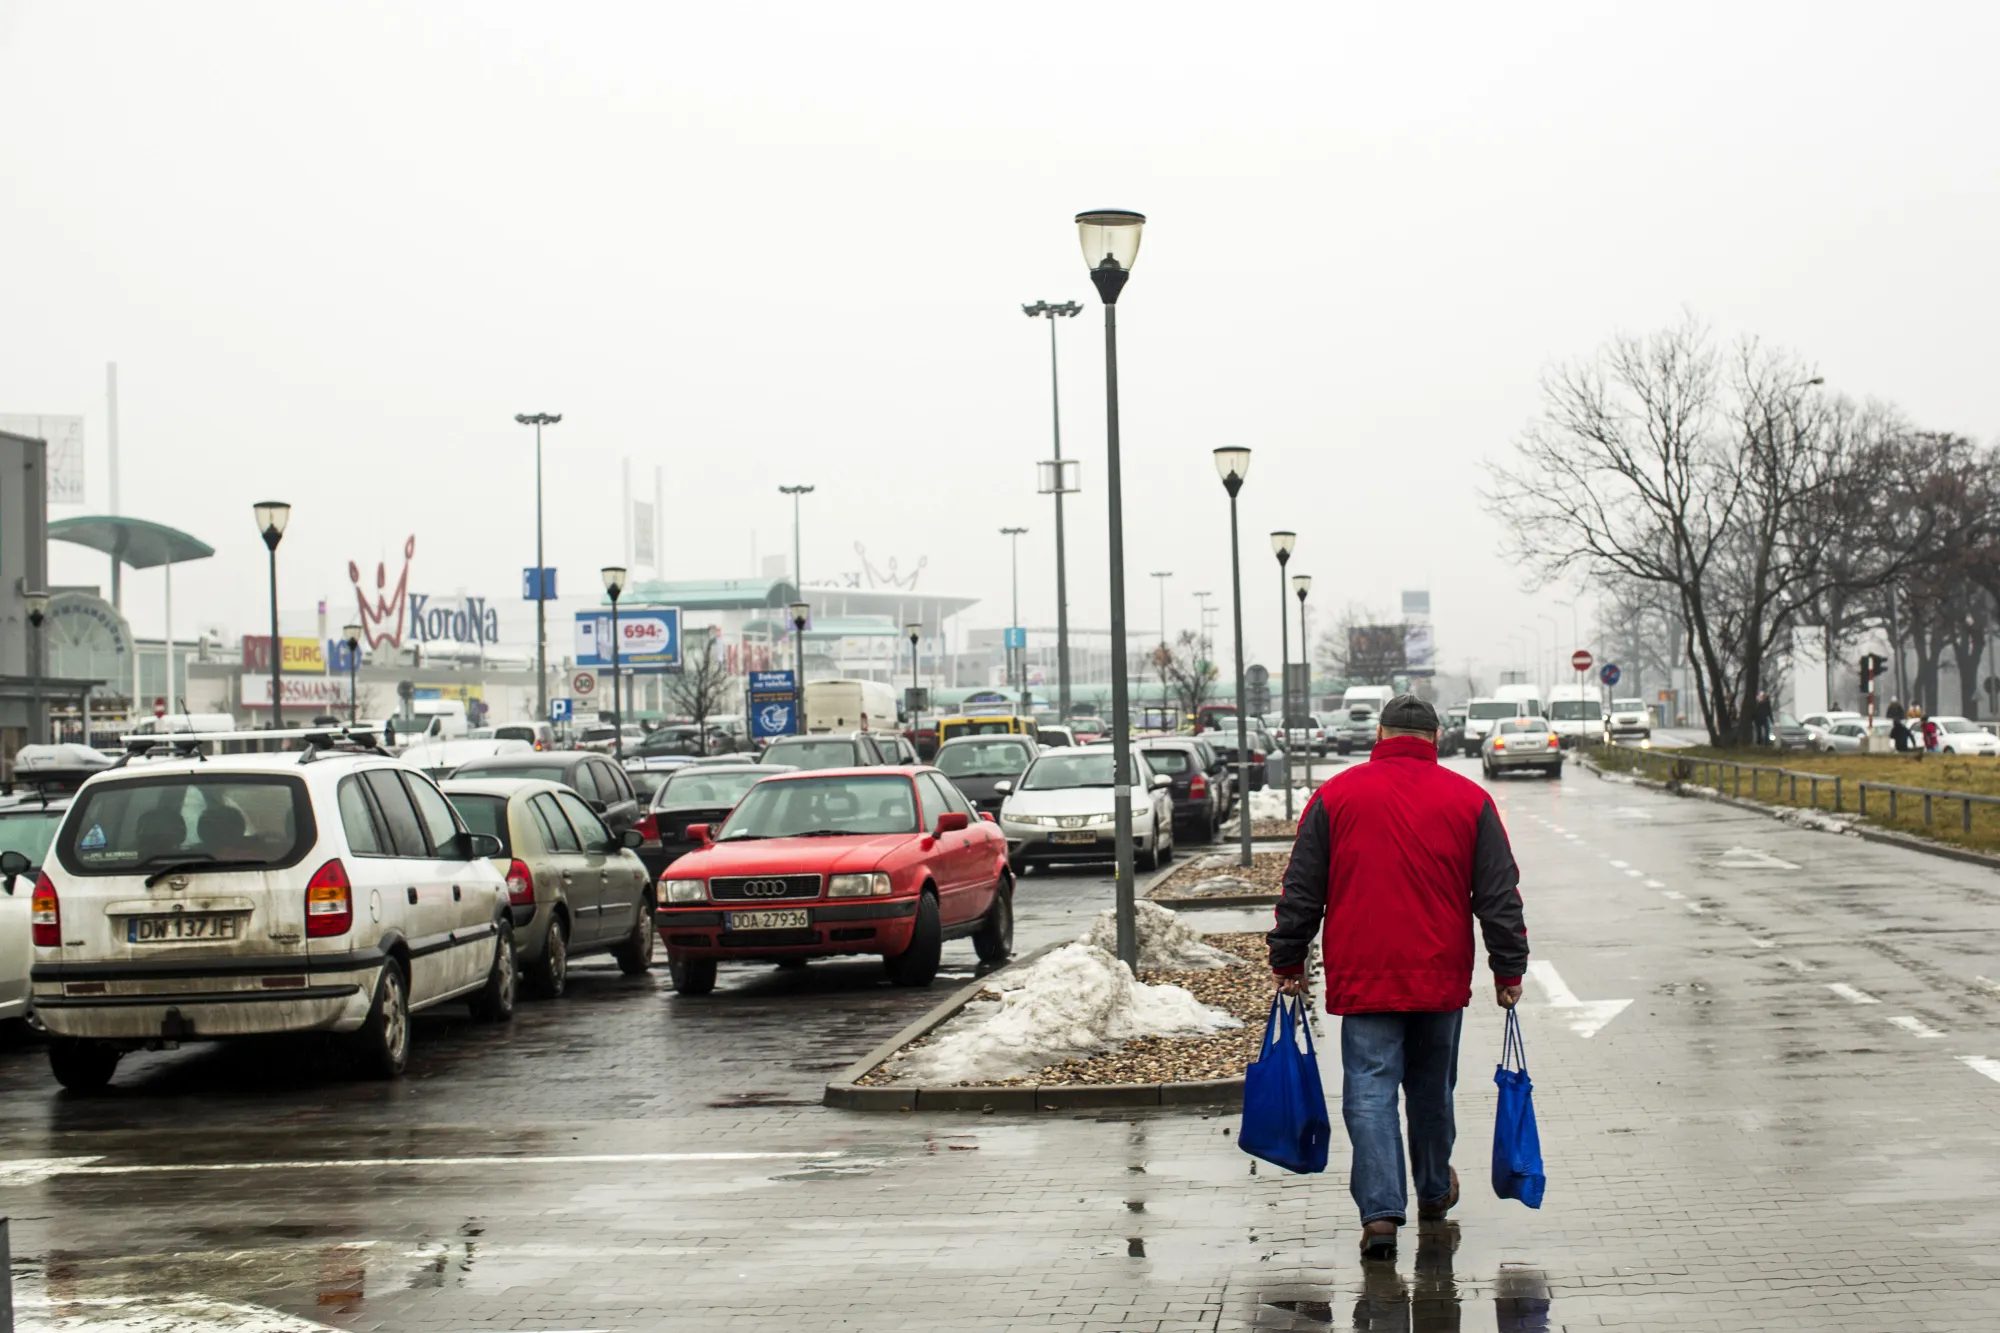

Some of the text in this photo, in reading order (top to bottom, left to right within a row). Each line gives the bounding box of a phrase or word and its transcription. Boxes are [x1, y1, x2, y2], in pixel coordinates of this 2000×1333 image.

[408, 593, 499, 648] KoroNa
[577, 678, 591, 689] 30
[552, 700, 566, 719] P
[140, 917, 234, 939] DW 137JF
[763, 910, 807, 928] 27936
